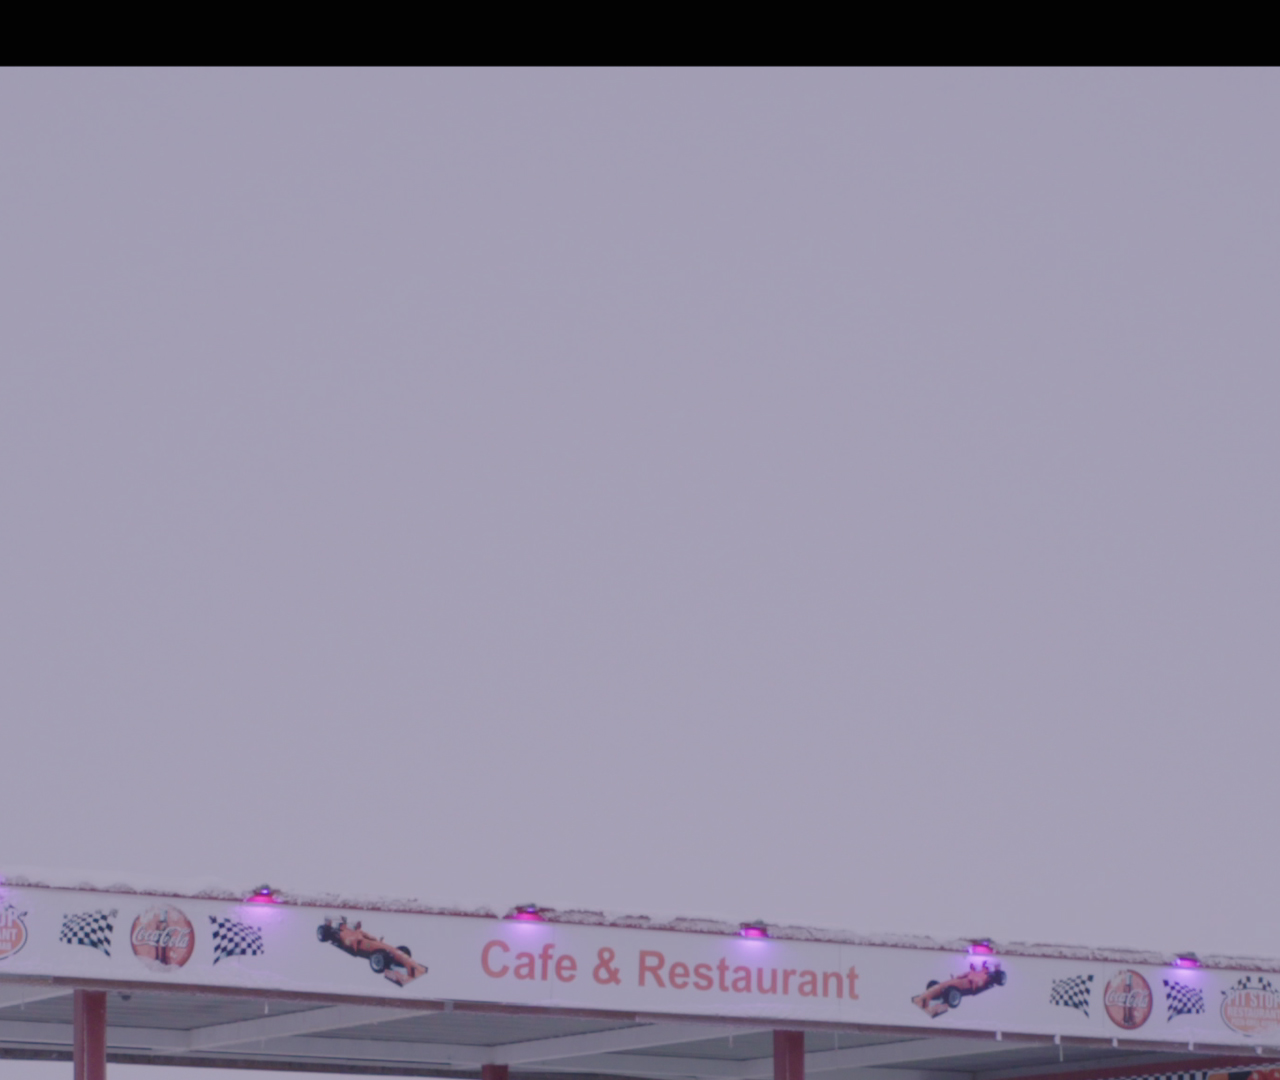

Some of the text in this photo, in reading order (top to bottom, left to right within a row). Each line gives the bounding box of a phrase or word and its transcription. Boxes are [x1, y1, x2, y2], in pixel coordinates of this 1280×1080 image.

[481, 939, 860, 1001] Cafe & Restaurant
